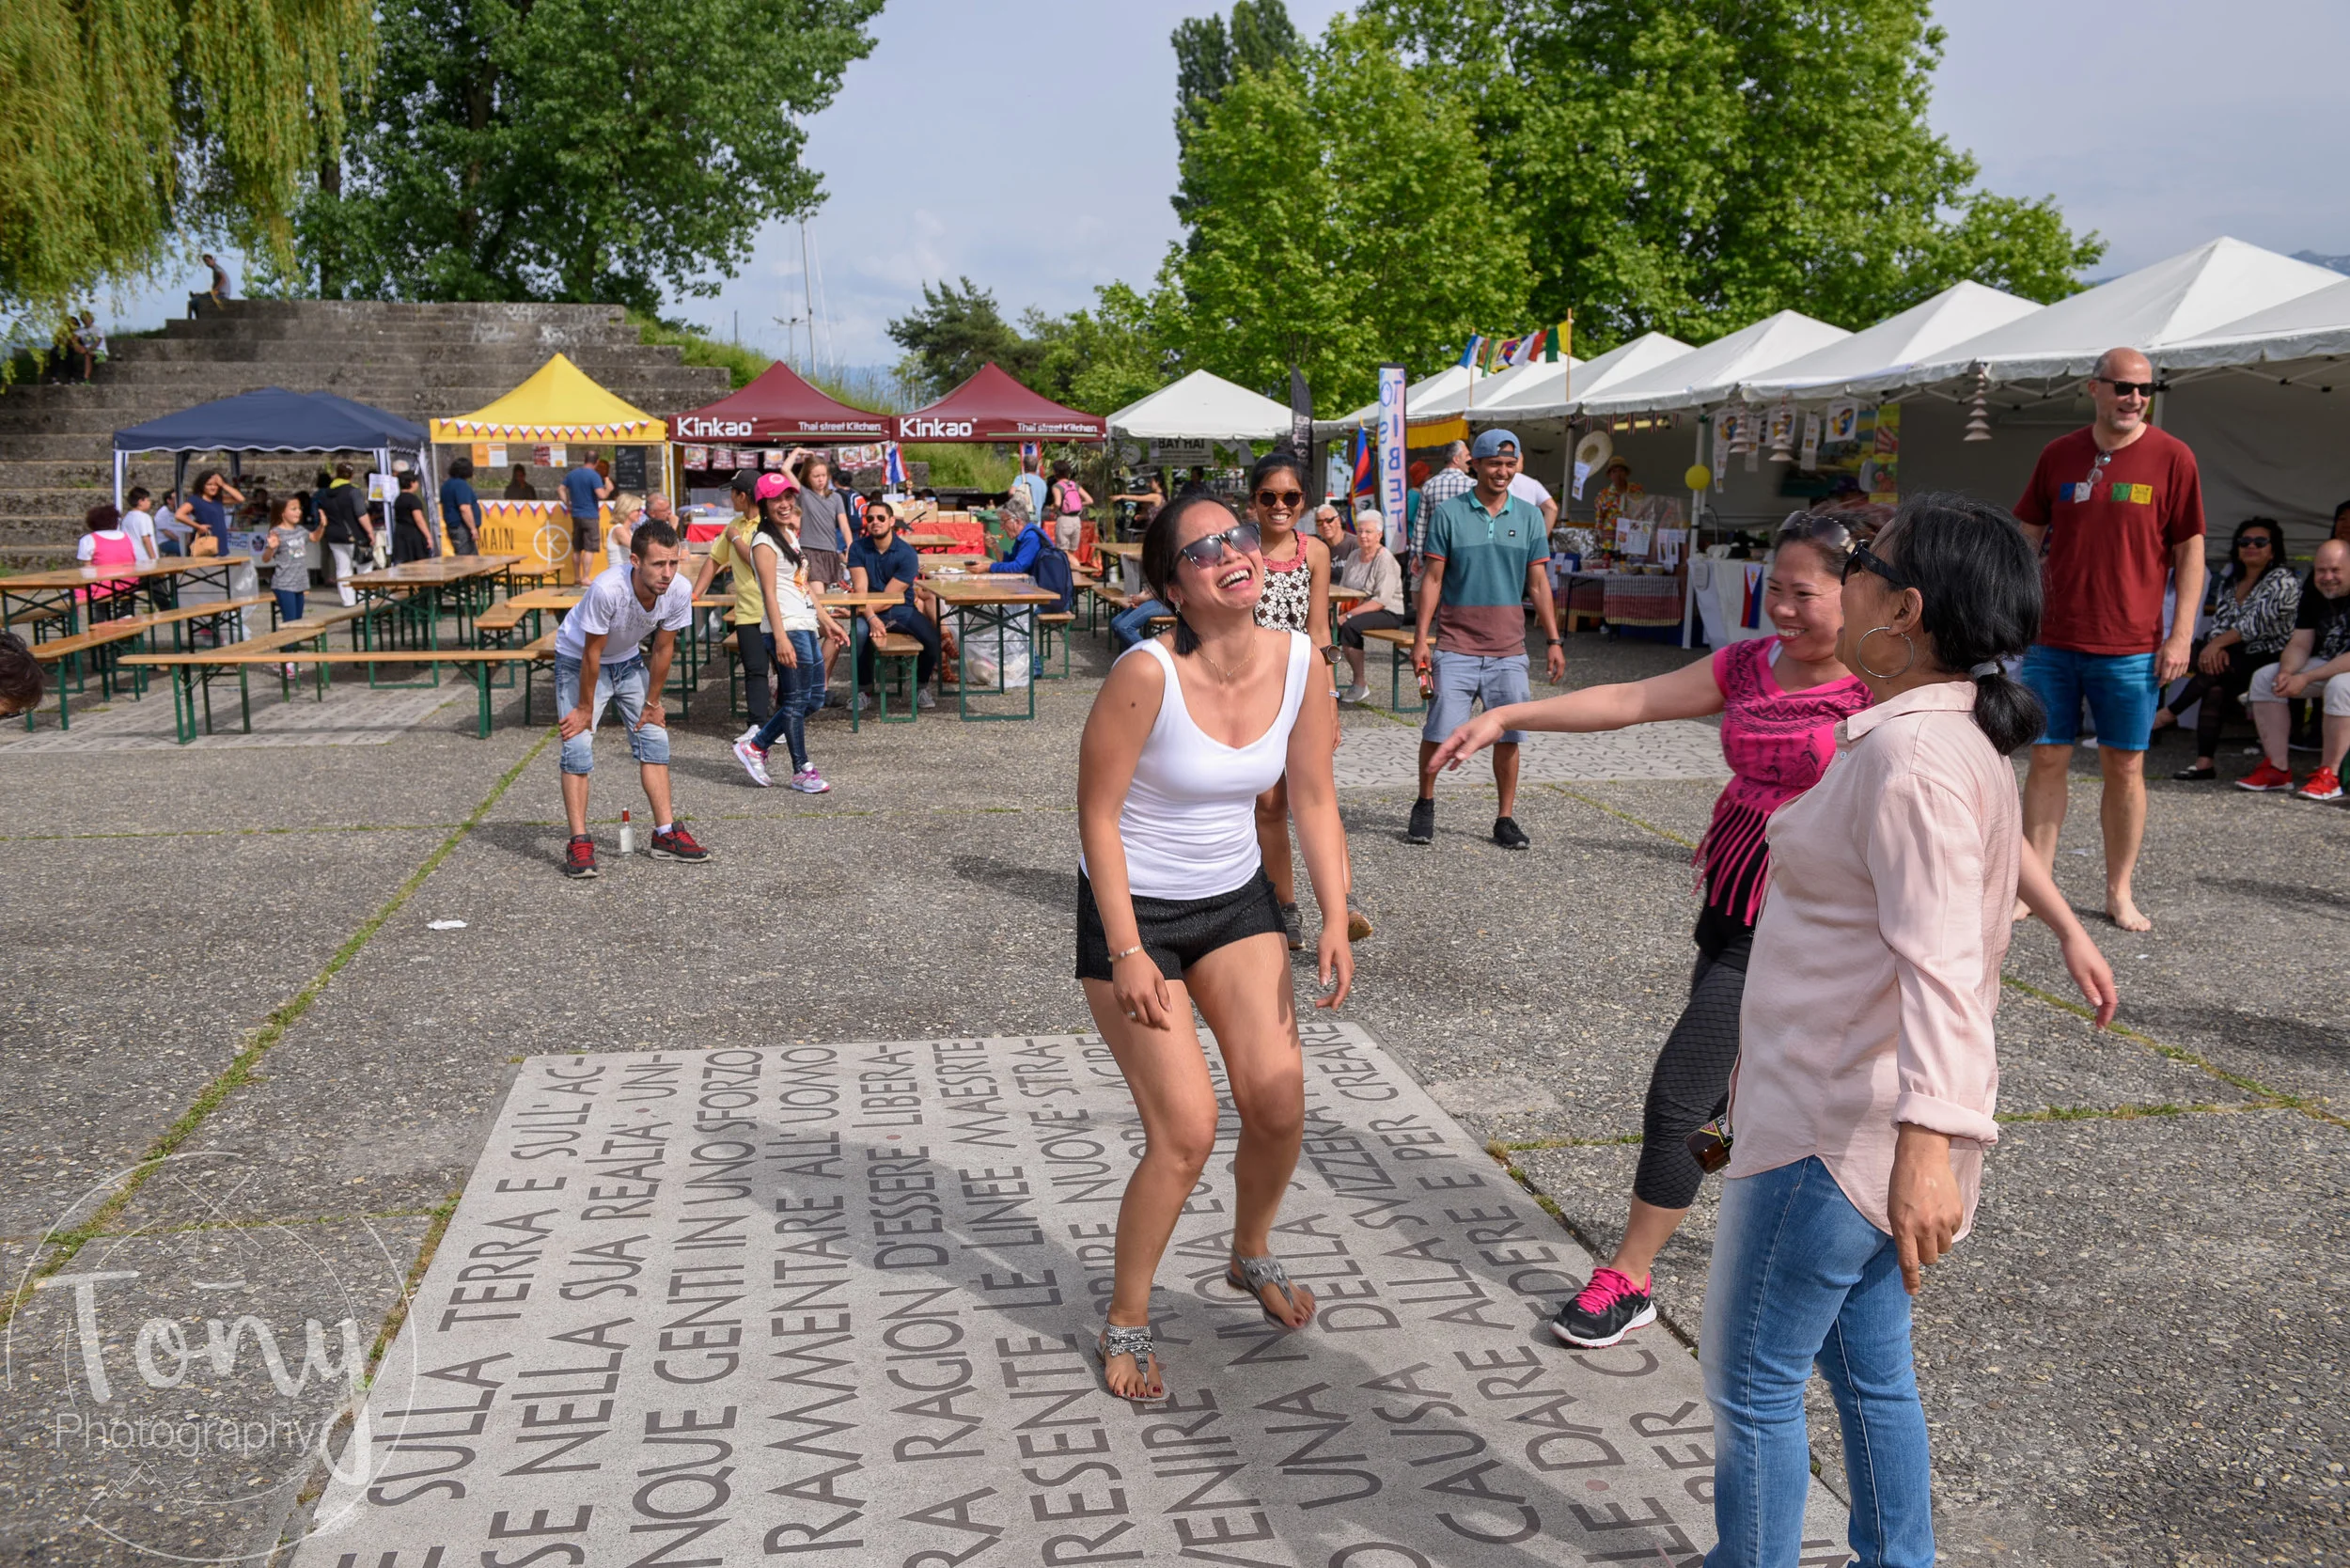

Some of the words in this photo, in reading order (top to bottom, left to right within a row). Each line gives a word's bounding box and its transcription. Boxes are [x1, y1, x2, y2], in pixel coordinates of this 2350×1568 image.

[677, 417, 752, 437] Kinkao
[798, 421, 819, 431] Thai
[820, 421, 846, 431] street
[846, 421, 882, 431] Kitchen
[900, 417, 973, 437] Kinkao
[1017, 422, 1037, 432] Thai
[1063, 423, 1098, 432] Kitchen
[693, 1051, 762, 1133] SFORZO
[932, 1043, 1017, 1148] MAESRTE
[1369, 1115, 1457, 1161] PER
[495, 1177, 567, 1193] E
[682, 1141, 756, 1205] UNO
[1028, 1109, 1123, 1203] NUOVE
[1416, 1174, 1486, 1190] E
[672, 1215, 748, 1250] IN
[959, 1167, 1044, 1249] LINEE
[438, 1209, 560, 1332] TERRA
[559, 1234, 650, 1300] SUA
[968, 1269, 1063, 1311] LE
[1381, 1237, 1514, 1330] ALLA
[653, 1264, 745, 1384] GENTI
[500, 1317, 634, 1477] NELLA
[763, 1196, 867, 1555] RAMMENTARE
[879, 1288, 984, 1463] RAGION
[1453, 1346, 1625, 1471] DARE
[367, 1353, 514, 1507] SULLA
[995, 1334, 1144, 1566] RESENTE
[1253, 1382, 1382, 1511] UNA
[1357, 1362, 1541, 1545] CAUSA
[626, 1406, 737, 1568] NQUE
